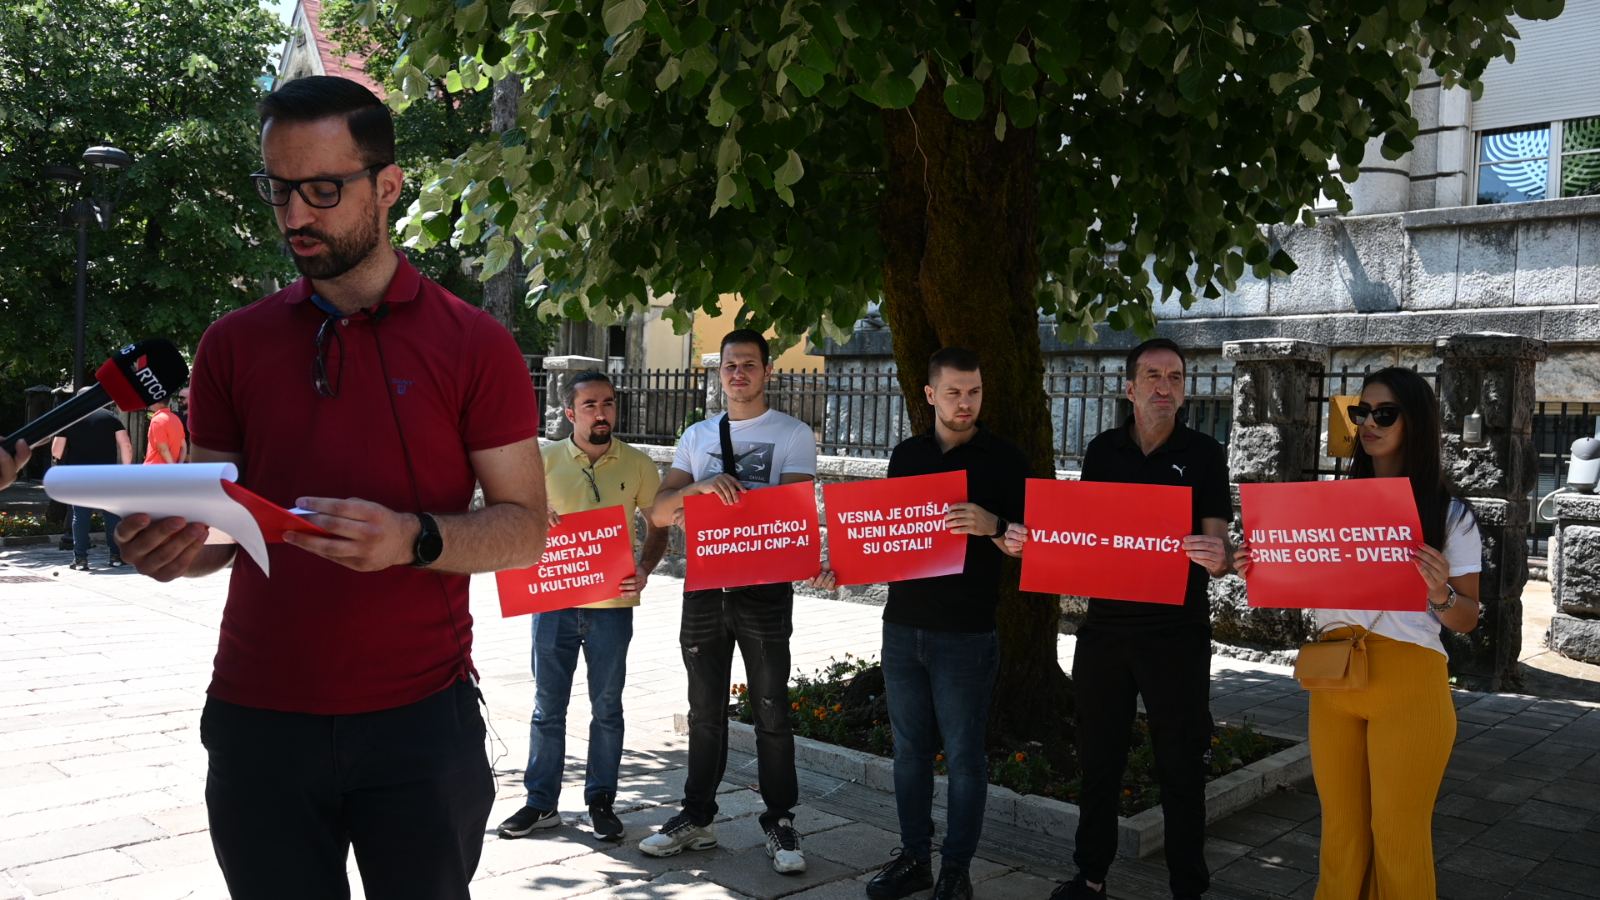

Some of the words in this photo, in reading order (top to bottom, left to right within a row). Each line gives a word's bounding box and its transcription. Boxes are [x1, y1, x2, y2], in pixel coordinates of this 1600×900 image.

[837, 509, 883, 524] VESNA
[886, 507, 902, 521] JE
[904, 501, 950, 519] OTIŠLA
[697, 528, 731, 542] STOP
[733, 519, 807, 539] POLITIČKOJ
[847, 525, 886, 540] NJENI
[889, 519, 946, 537] KADROVI
[1248, 529, 1266, 544] JU
[1269, 528, 1335, 544] FILMSKI
[1339, 526, 1412, 542] CENTAR
[545, 532, 577, 549] SKOJ
[696, 540, 762, 557] OKUPACIJI
[764, 534, 809, 550] CNP-A!
[863, 542, 880, 555] SU
[883, 537, 932, 554] OSTALI!
[1031, 528, 1097, 547] VLAOVIC
[1113, 535, 1181, 553] BRATIĆ?
[541, 544, 602, 563] SMETAJU
[1250, 548, 1292, 563] CRNE
[1295, 548, 1341, 563] GORE
[537, 560, 590, 578] ČETNICI
[528, 584, 538, 595] U
[541, 572, 604, 593] KULTURI?!
